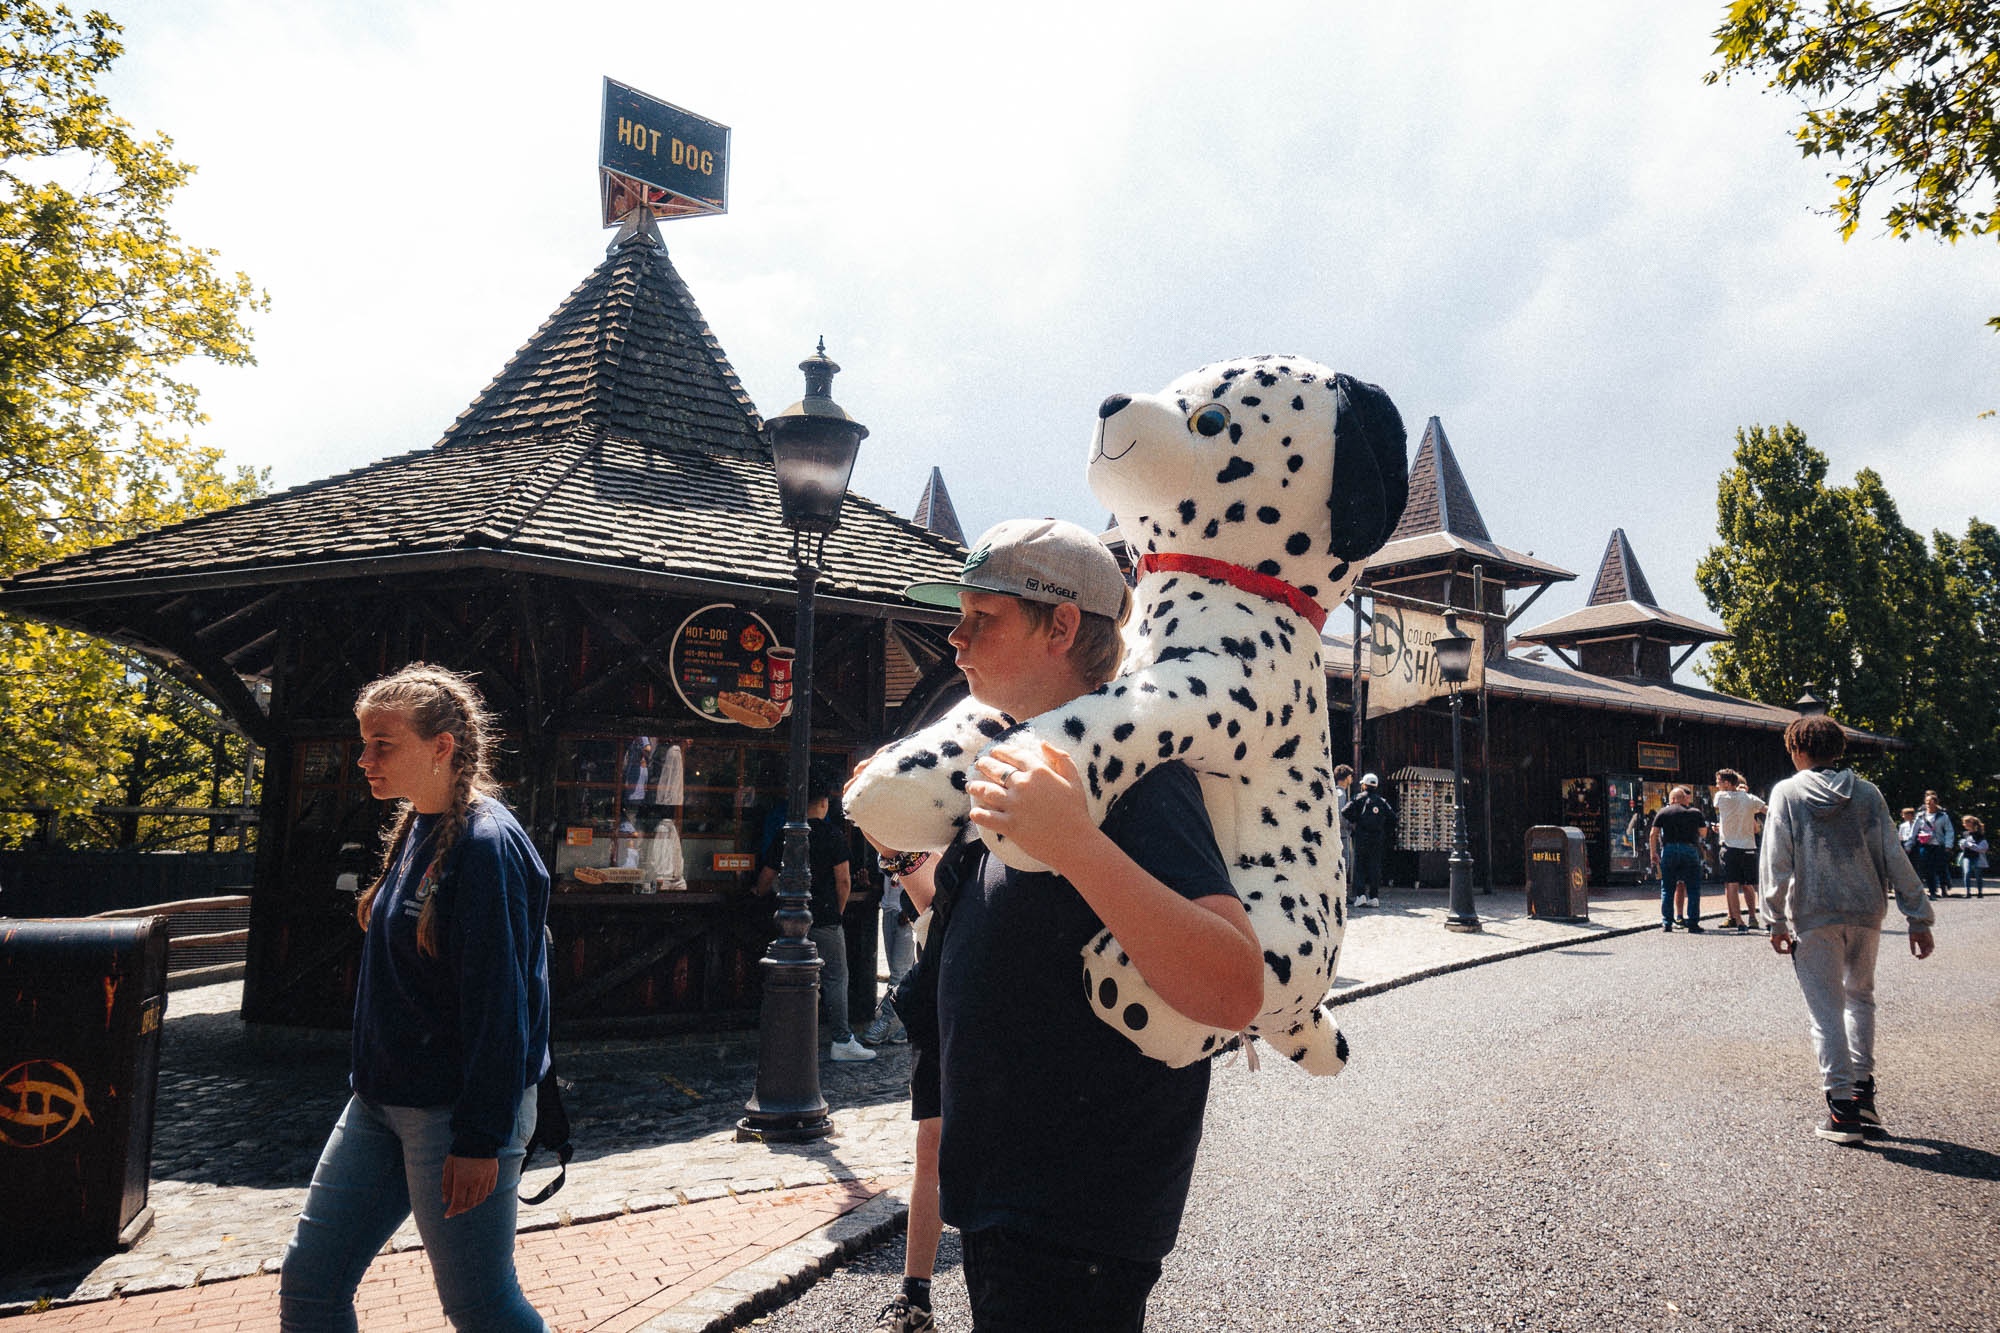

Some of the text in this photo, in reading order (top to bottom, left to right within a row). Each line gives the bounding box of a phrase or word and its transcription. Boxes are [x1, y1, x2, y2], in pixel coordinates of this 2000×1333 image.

[618, 117, 713, 176] HOT DOG
[1042, 583, 1078, 600] VÖGELE
[685, 626, 728, 640] HOT-DOG
[1403, 648, 1441, 687] SHO
[1532, 850, 1561, 863] ABFÄLLE
